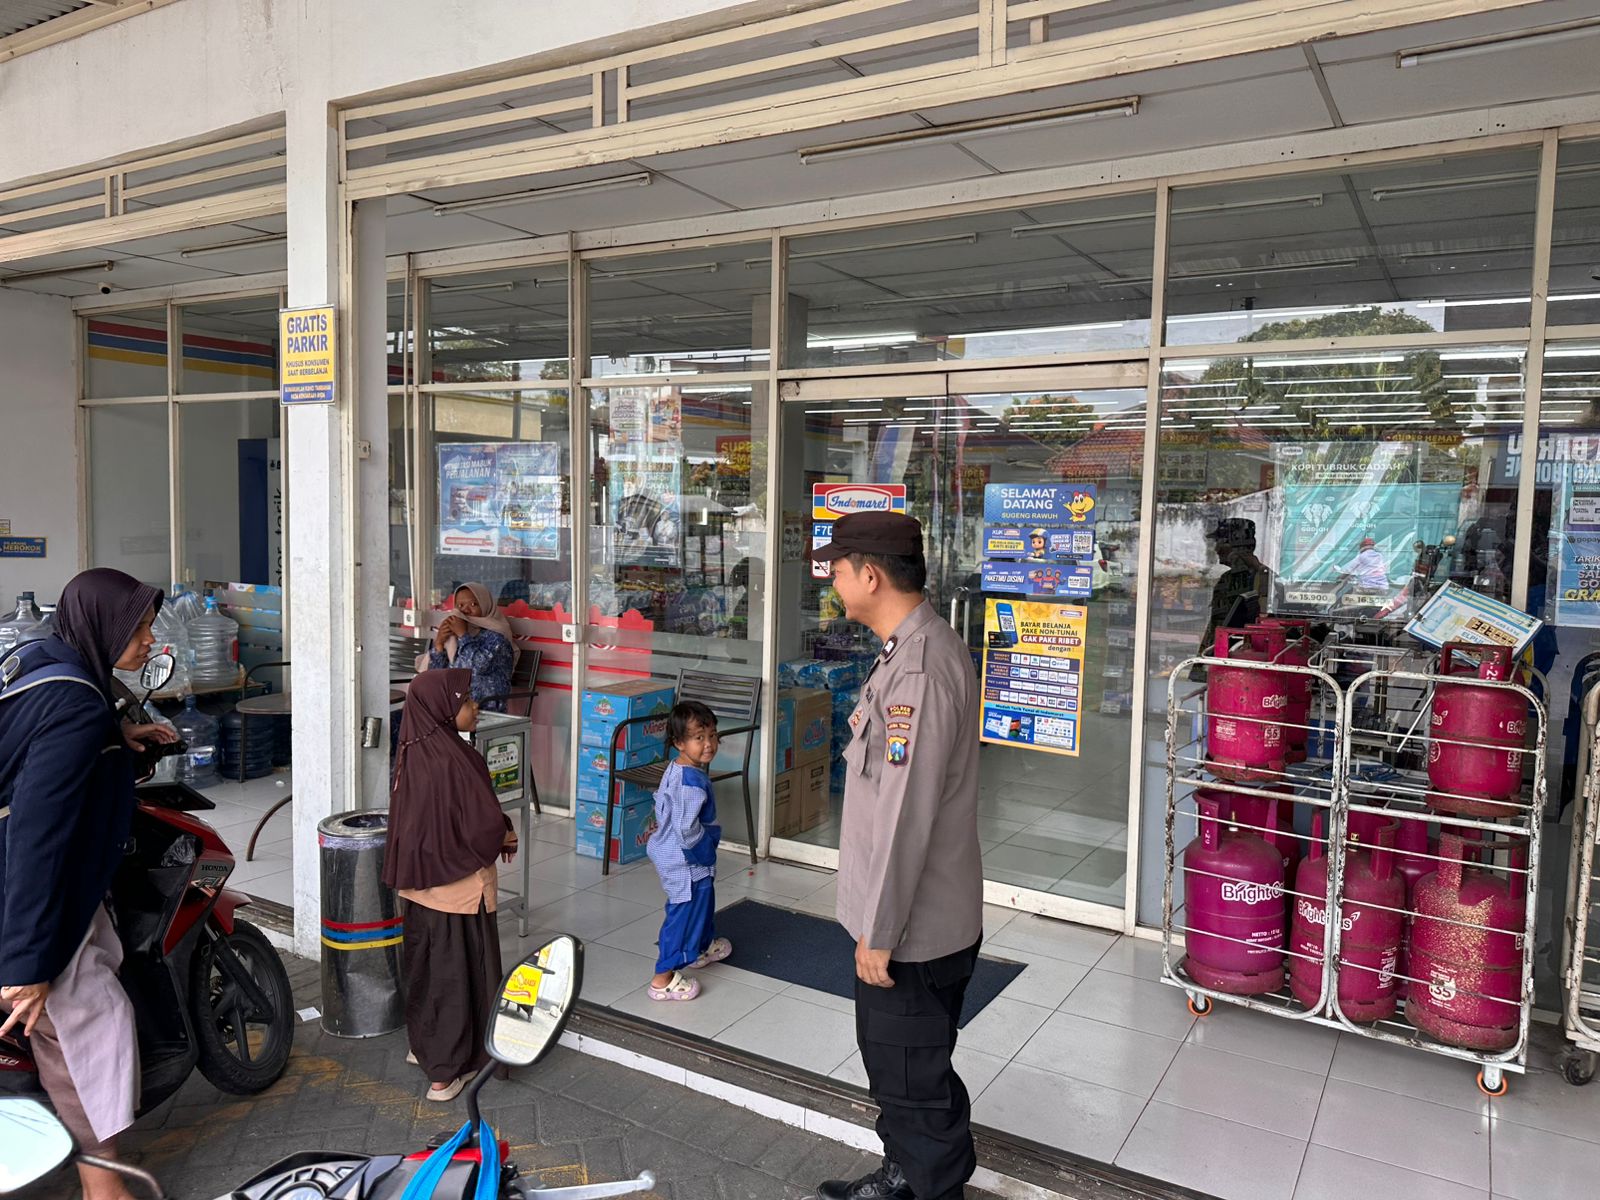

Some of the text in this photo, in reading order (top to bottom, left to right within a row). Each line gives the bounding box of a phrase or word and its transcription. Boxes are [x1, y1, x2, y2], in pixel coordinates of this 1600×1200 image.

[287, 314, 328, 334] GRATIS
[287, 334, 328, 353] PARKIR
[286, 360, 304, 368] KHUSUS
[299, 367, 328, 376] BERBELANJA
[1425, 434, 1458, 442] HEMAT
[1291, 462, 1401, 471] KOPI TUBRUK GADJAH
[445, 467, 491, 480] PERJALANAN
[1001, 488, 1058, 498] SELAMAT
[829, 495, 888, 508] Indomaret
[1003, 499, 1053, 509] DATANG
[1577, 536, 1600, 544] gopay
[1573, 555, 1600, 563] TARIK
[1299, 593, 1328, 601] 15.900
[1022, 635, 1079, 645] GAK PAKE RIBET
[201, 864, 229, 872] HONDA
[1222, 881, 1272, 905] Bright
